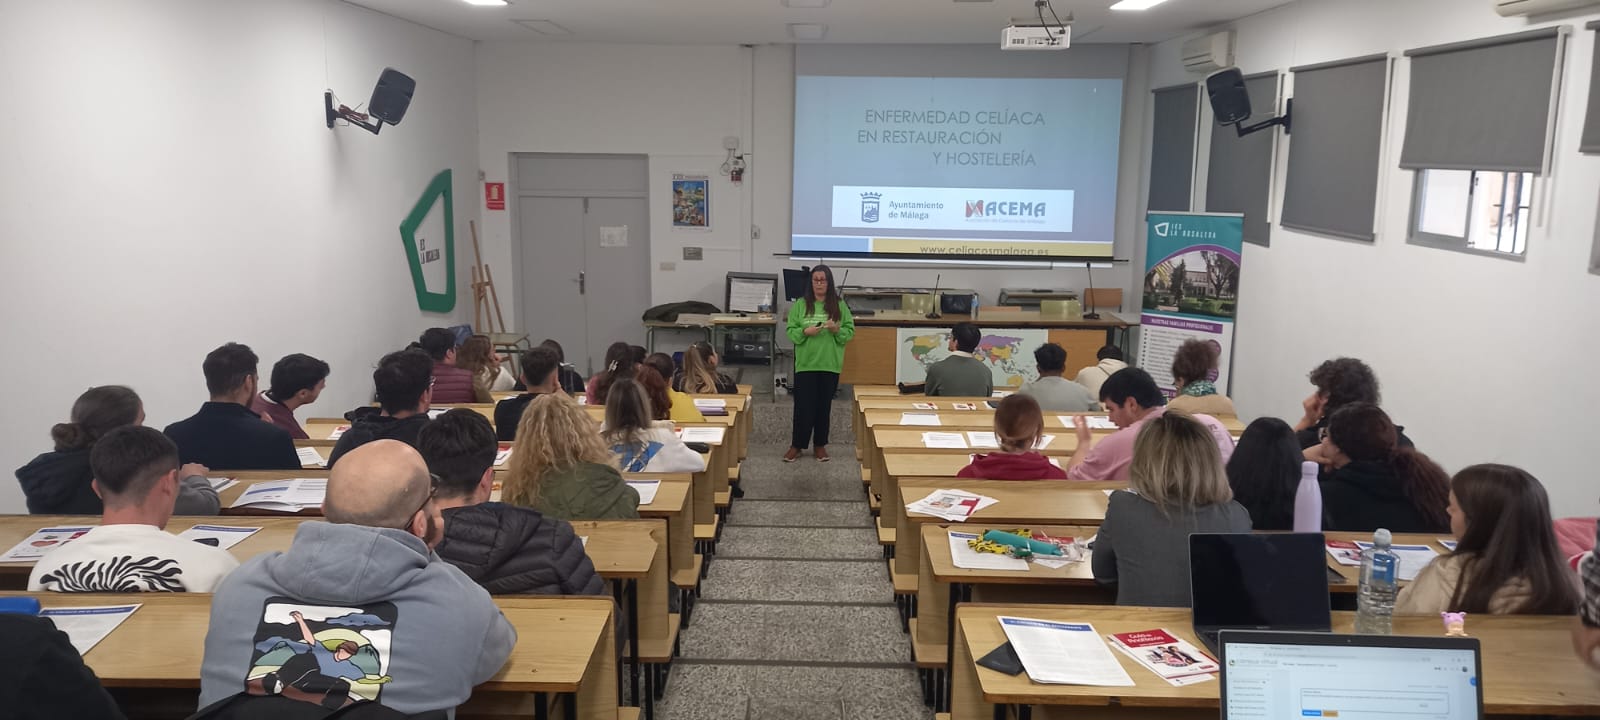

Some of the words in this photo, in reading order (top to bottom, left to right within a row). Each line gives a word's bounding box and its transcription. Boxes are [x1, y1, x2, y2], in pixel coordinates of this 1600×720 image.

[865, 109, 970, 124] ENFERMEDAD
[975, 108, 1046, 126] CELÍACA
[857, 129, 878, 143] EN
[882, 129, 1002, 145] RESTAURACIÓN
[932, 151, 942, 165] Y
[946, 150, 1037, 167] HOSTELERÍA
[888, 200, 944, 211] Ayuntamiento
[888, 211, 898, 219] de
[900, 210, 930, 220] Málaga
